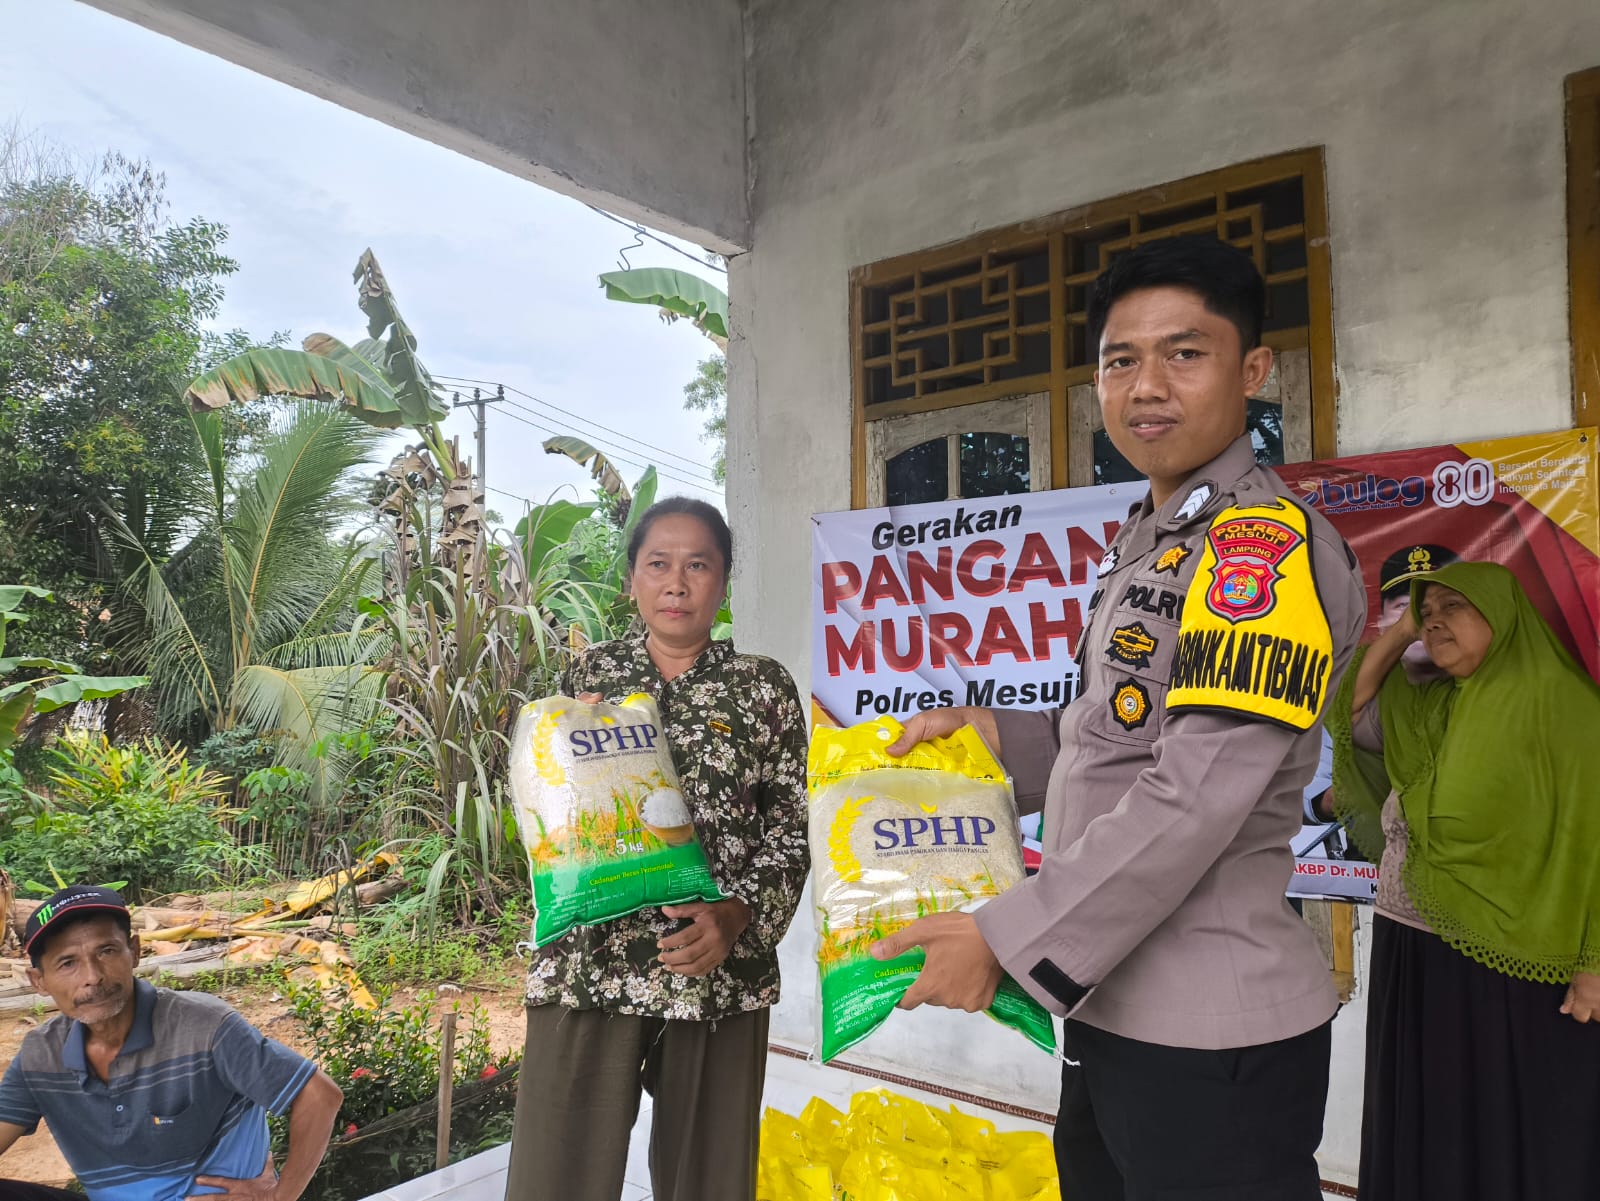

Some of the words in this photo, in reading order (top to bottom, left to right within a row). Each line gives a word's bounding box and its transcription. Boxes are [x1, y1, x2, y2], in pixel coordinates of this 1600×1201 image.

[1321, 474, 1426, 507] bulog
[1432, 458, 1494, 508] 80
[871, 504, 1022, 551] Gerakan
[1215, 523, 1290, 542] POLRES
[1224, 531, 1279, 545] MESUJI
[821, 520, 1122, 615] PANGAN
[1223, 546, 1272, 558] LAMPUNG
[1119, 584, 1186, 622] POLRI
[824, 598, 1083, 677] MURAH
[855, 687, 954, 716] Polres
[569, 723, 658, 757] SPHP
[616, 838, 627, 855] 5
[629, 840, 644, 853] kg
[873, 815, 996, 851] SPHP
[1330, 865, 1350, 877] Dr.
[874, 965, 915, 979] Cadangan
